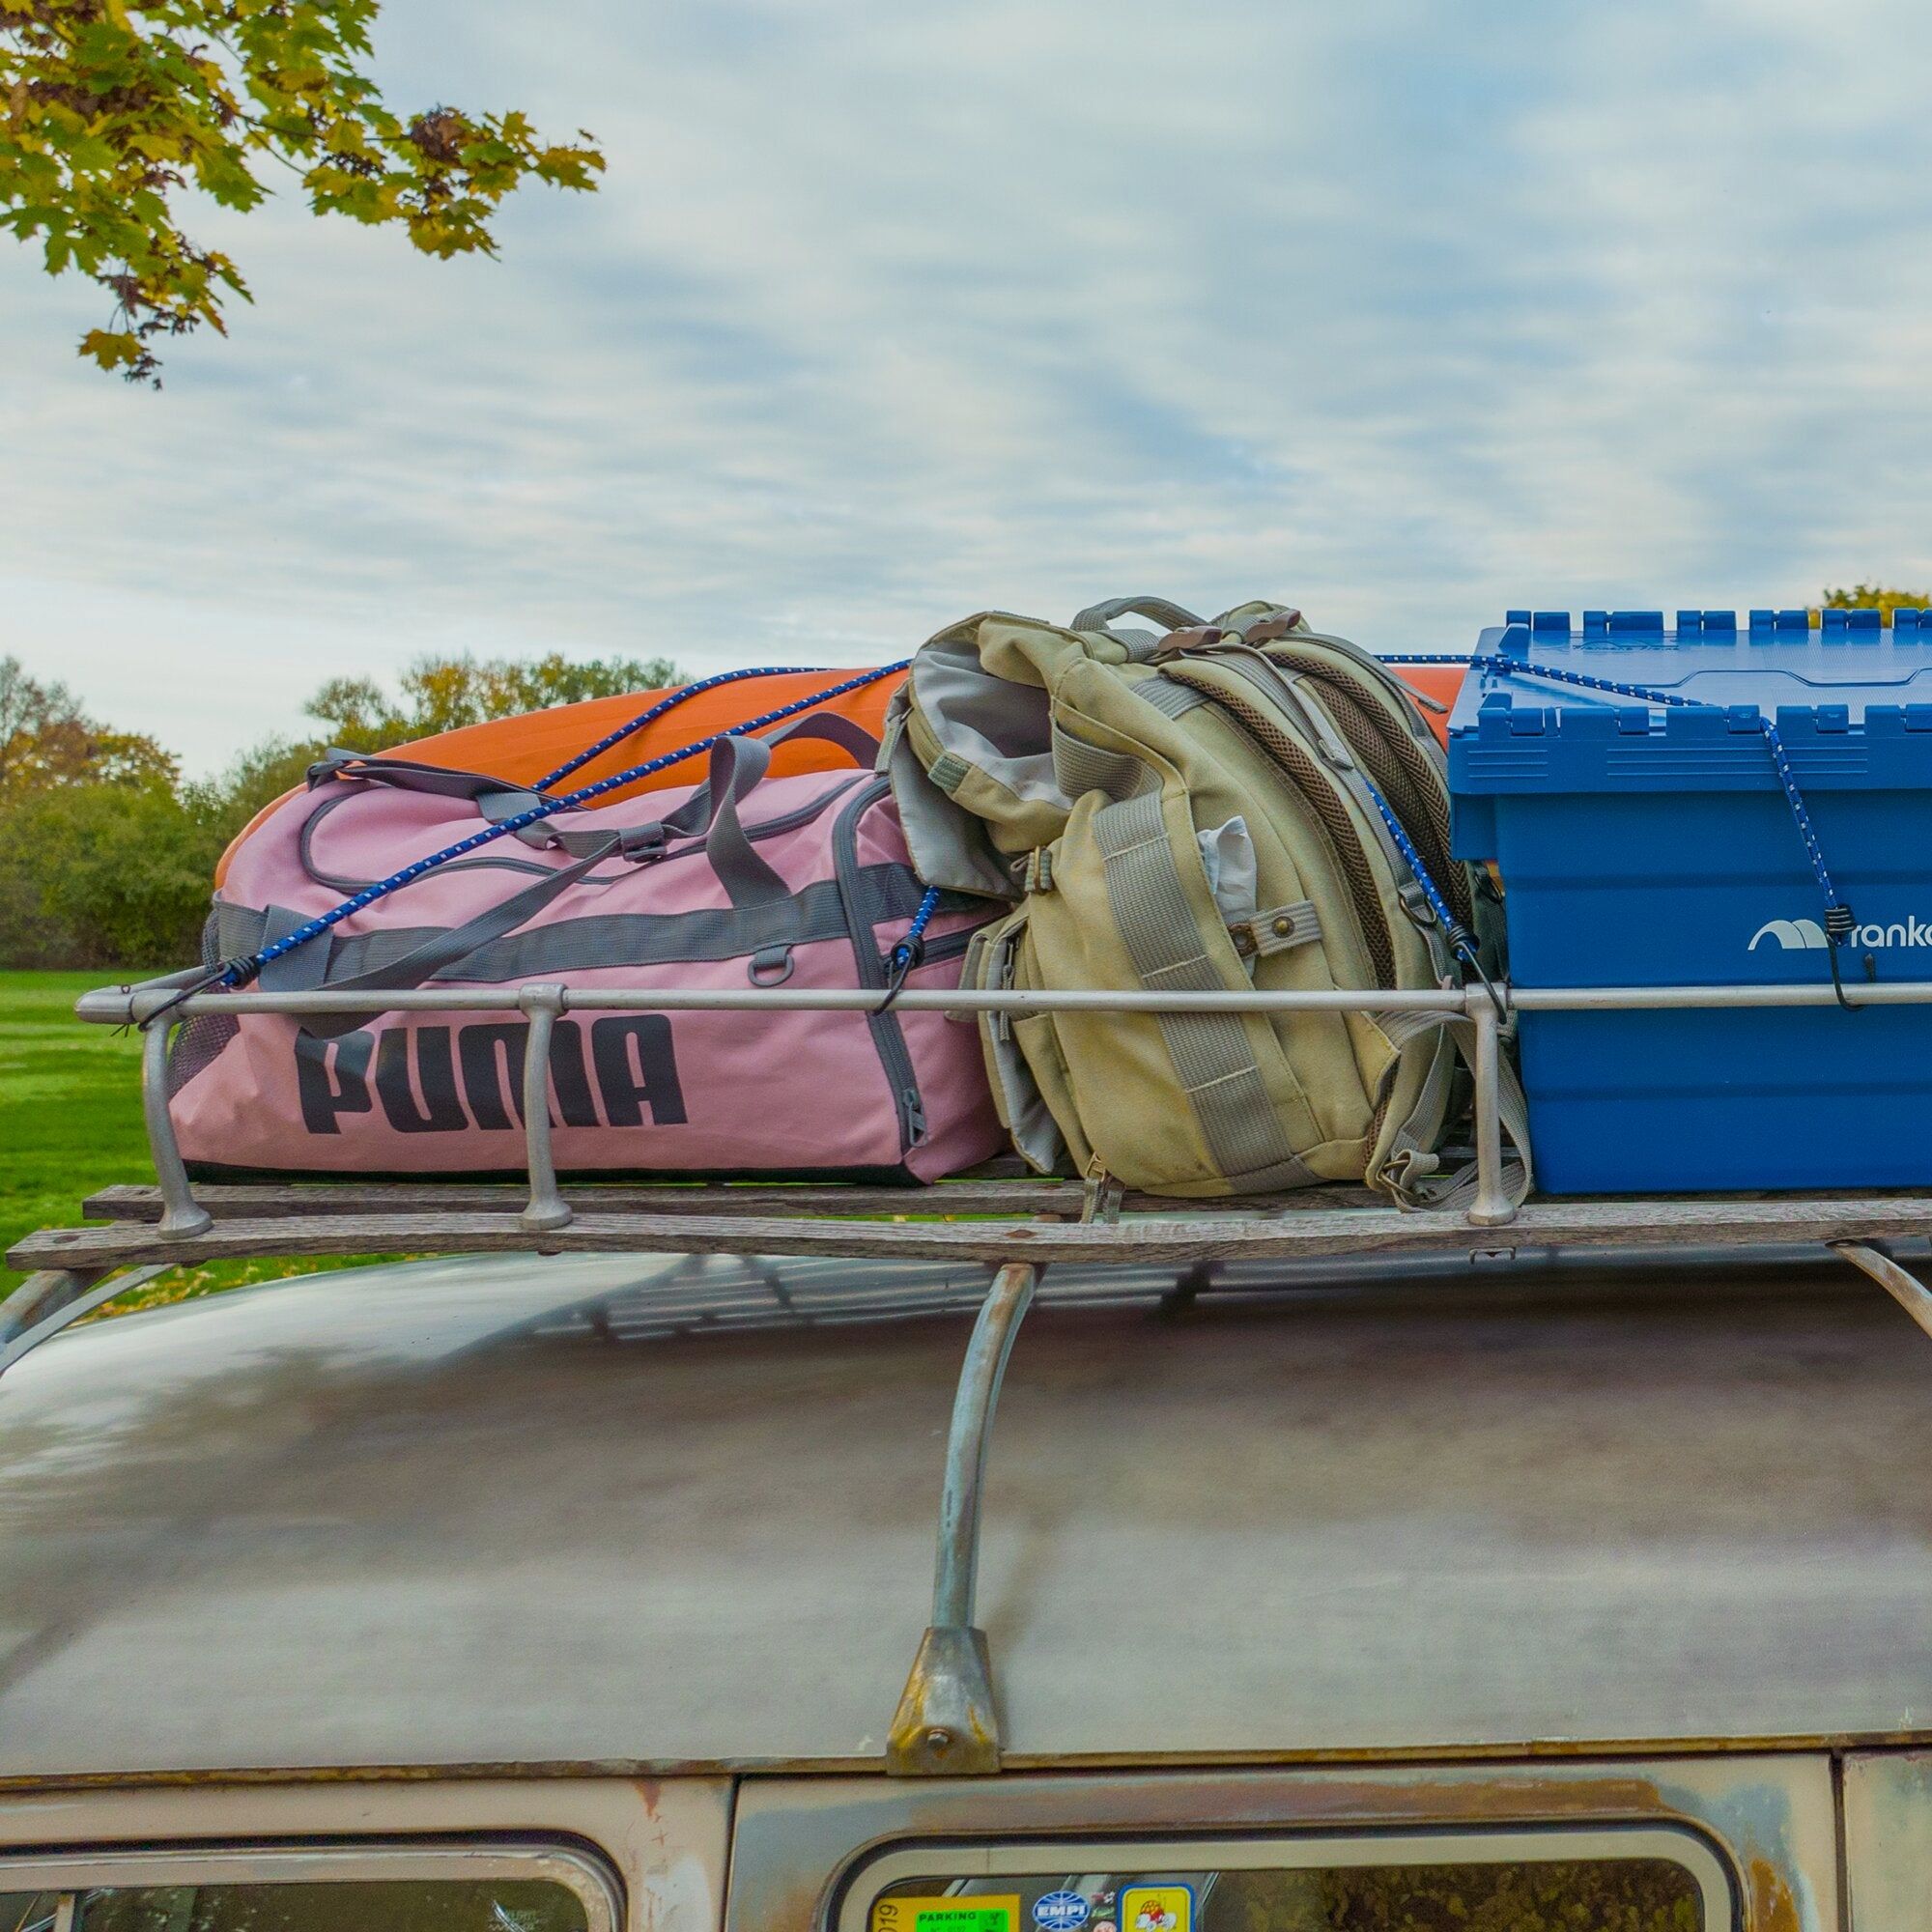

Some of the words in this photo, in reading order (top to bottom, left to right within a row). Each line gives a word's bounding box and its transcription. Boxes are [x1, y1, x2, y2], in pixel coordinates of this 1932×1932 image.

[1849, 915, 1932, 948] rank
[295, 1014, 689, 1134] PUMA
[919, 1912, 977, 1921] PARKING
[1037, 1904, 1086, 1917] EMPI
